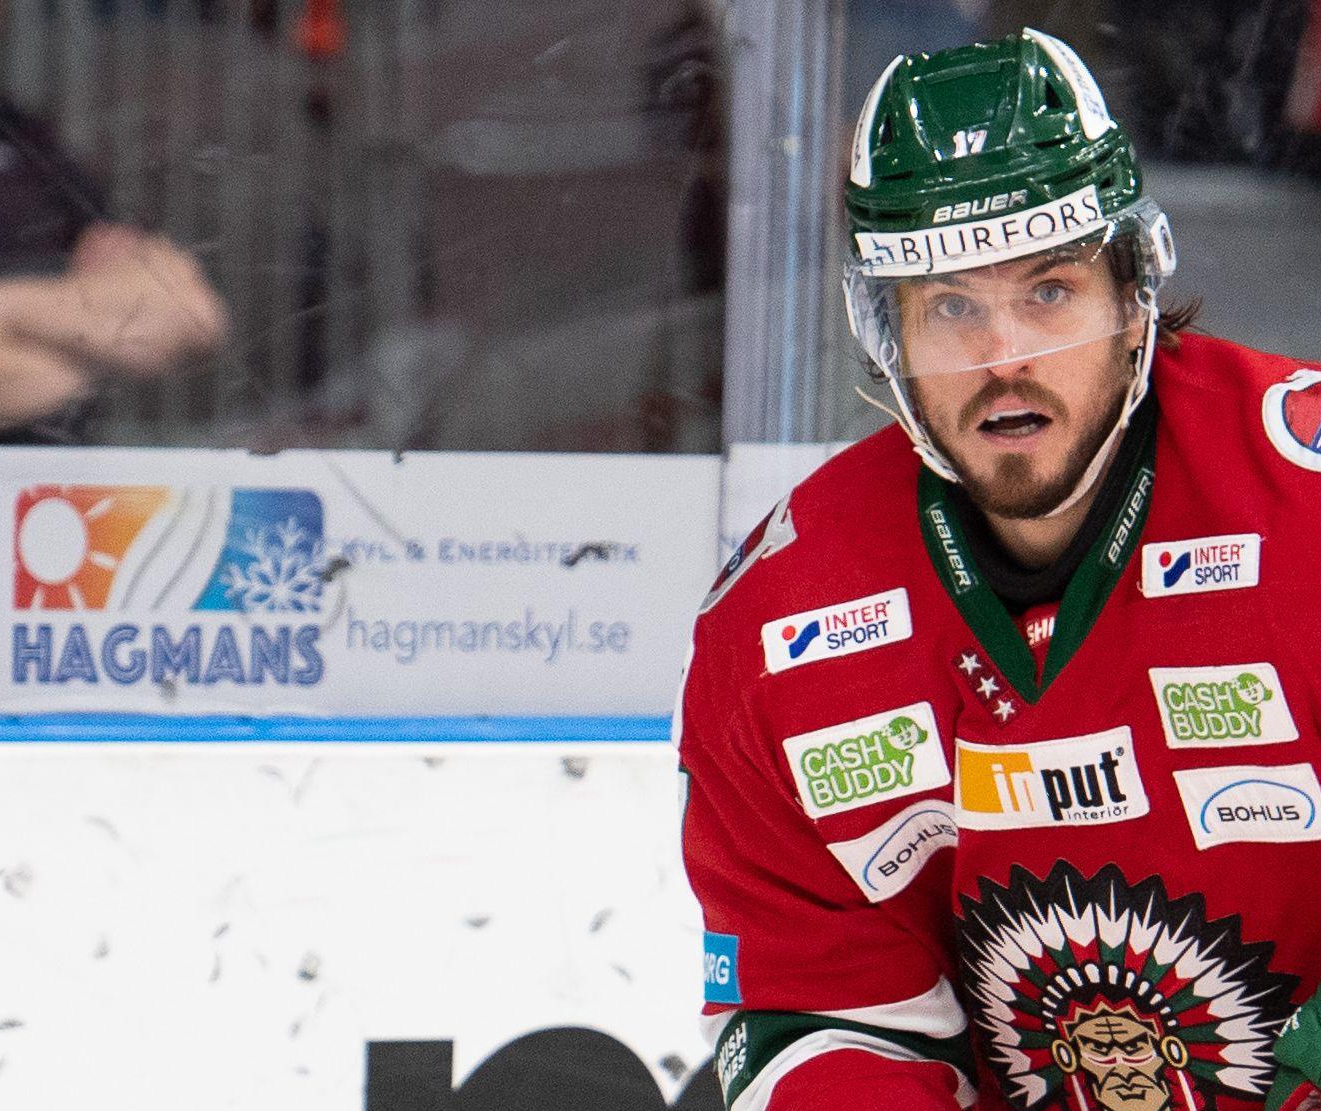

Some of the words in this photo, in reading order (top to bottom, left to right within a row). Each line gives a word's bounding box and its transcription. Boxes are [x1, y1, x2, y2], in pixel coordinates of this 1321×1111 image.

[952, 130, 987, 159] 17
[901, 195, 1101, 272] BJURFORS
[1195, 544, 1241, 565] INTER
[1195, 563, 1241, 586] SPORT
[825, 602, 888, 631] INTER
[346, 606, 633, 664] hagmanskyl.se
[826, 621, 890, 651] SPORT
[11, 622, 326, 687] HAGMANS
[1166, 683, 1235, 712] CASH
[1170, 709, 1262, 739] BUDDY
[803, 733, 885, 778] CASH
[812, 757, 916, 807] BUDDY
[1218, 805, 1301, 823] BOHUS
[877, 822, 958, 878] BOHUS
